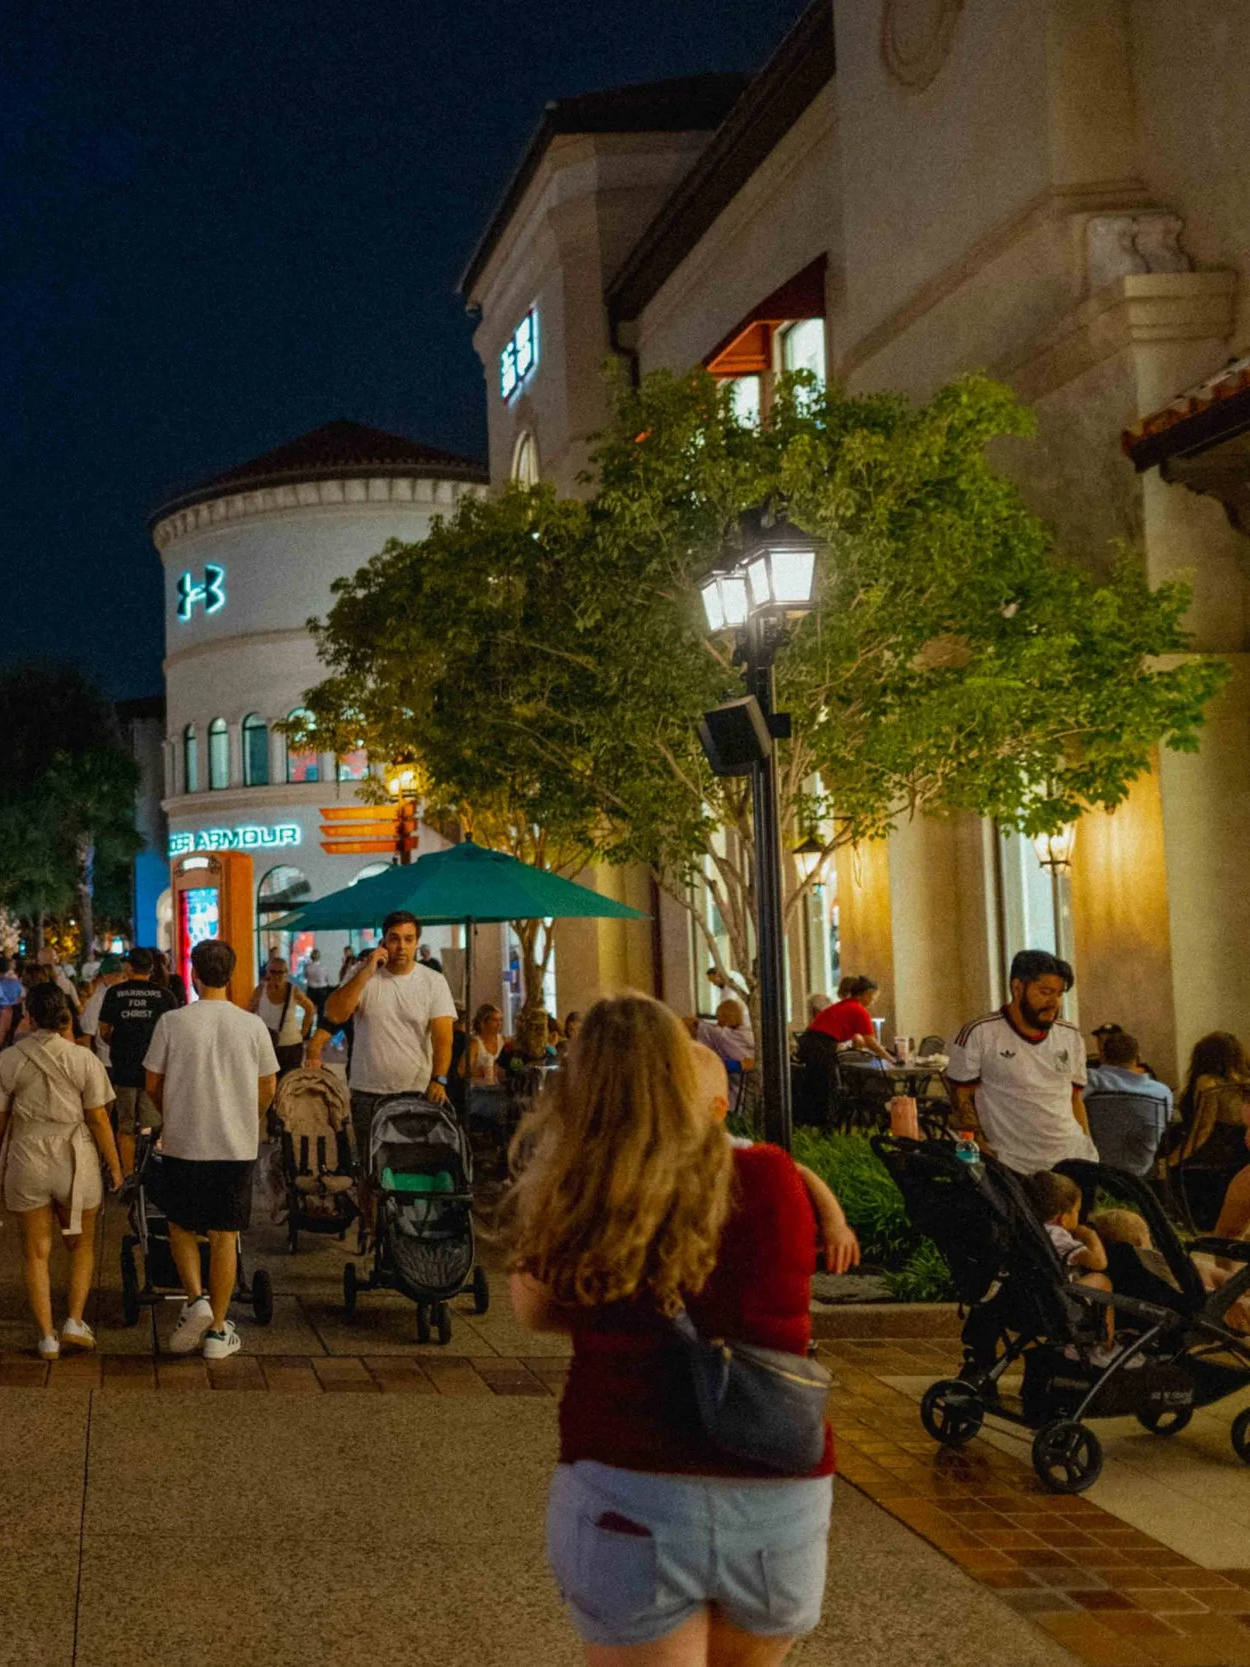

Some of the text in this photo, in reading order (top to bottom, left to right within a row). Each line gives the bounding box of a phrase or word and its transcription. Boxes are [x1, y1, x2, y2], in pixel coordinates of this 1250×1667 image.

[194, 823, 299, 852] ARMOUR
[116, 989, 162, 998] WARRIORS
[128, 998, 147, 1007] FOR
[120, 1009, 153, 1019] CHRIST
